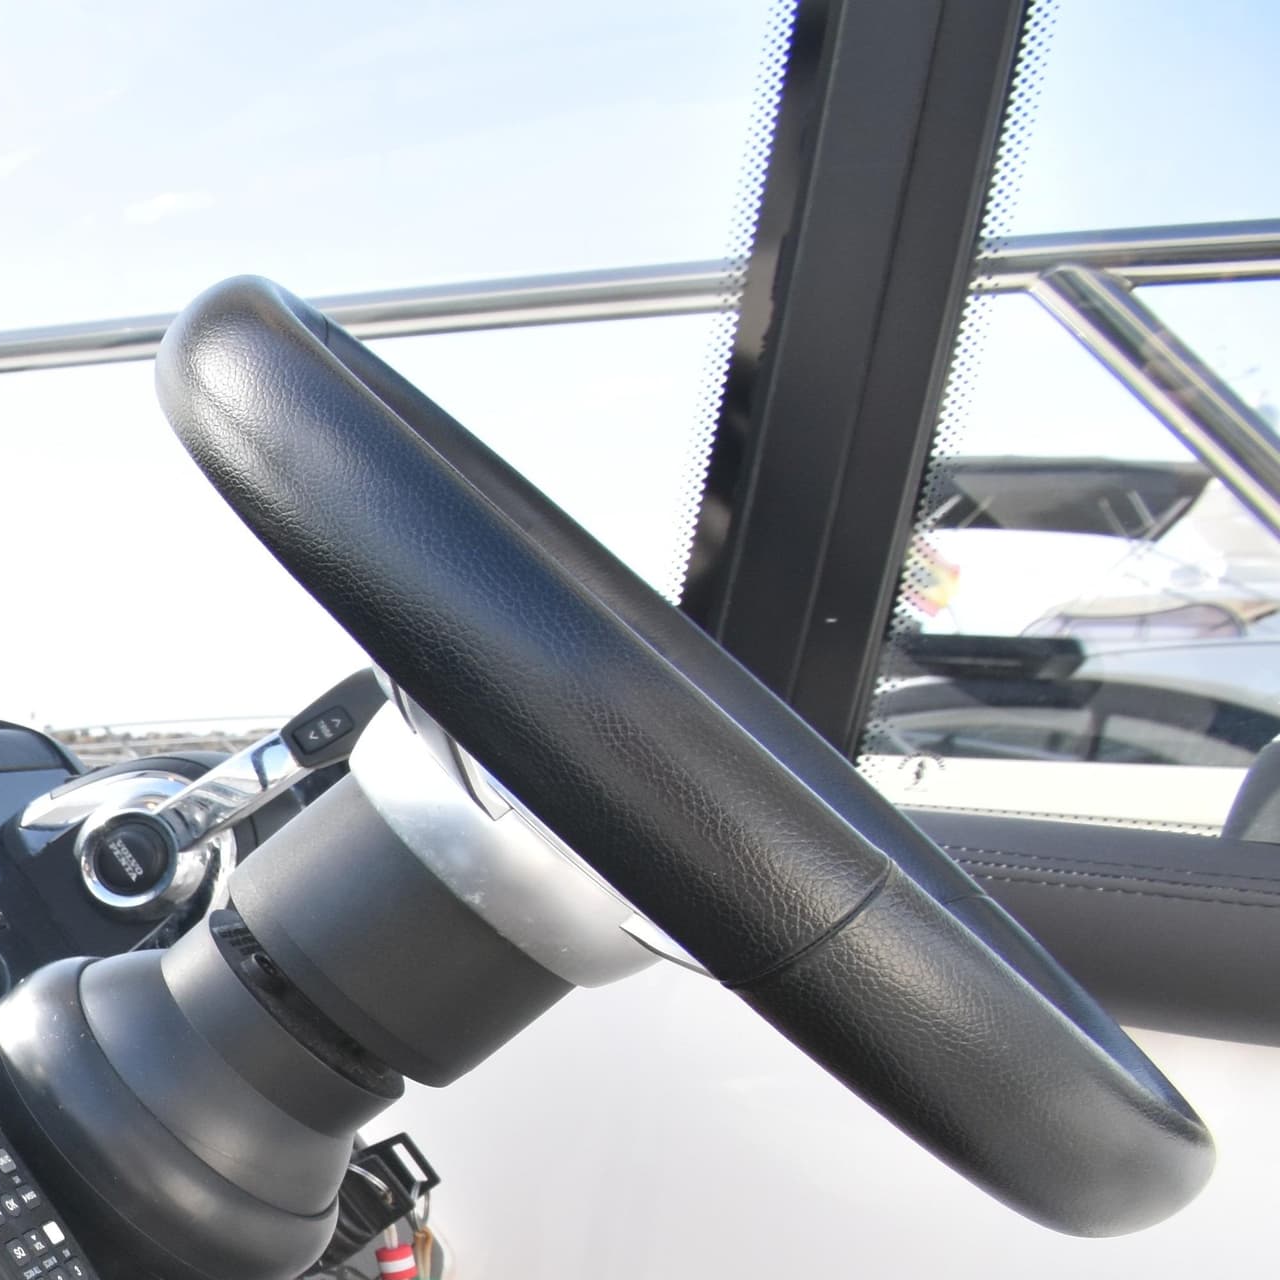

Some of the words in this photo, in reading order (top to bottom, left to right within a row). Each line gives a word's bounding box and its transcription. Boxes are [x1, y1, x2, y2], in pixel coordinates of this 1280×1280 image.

[108, 842, 137, 882] PENTA
[116, 839, 144, 876] VOLVO
[5, 1198, 19, 1211] OK
